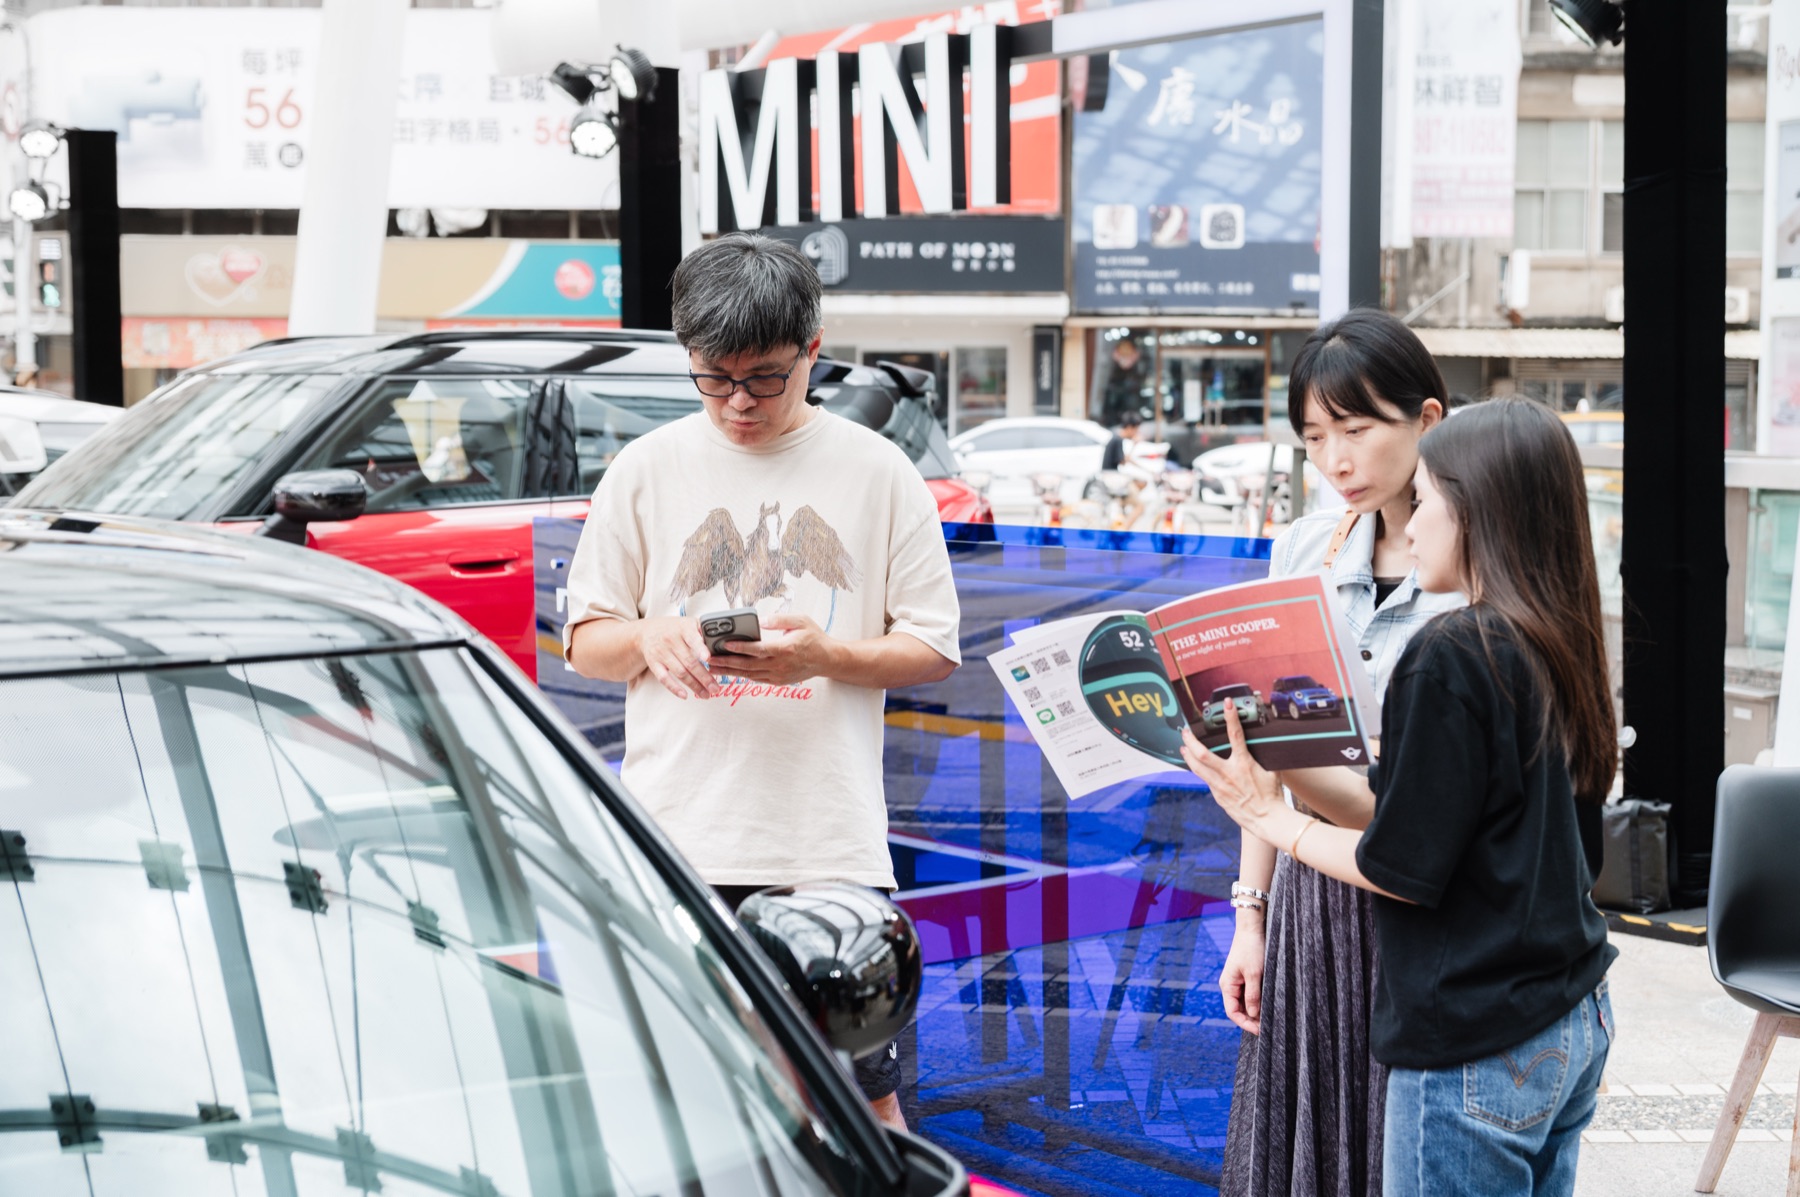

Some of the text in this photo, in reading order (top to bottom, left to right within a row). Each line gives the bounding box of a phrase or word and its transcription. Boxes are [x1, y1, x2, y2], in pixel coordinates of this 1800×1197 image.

[244, 86, 302, 129] 56
[699, 22, 1011, 235] MINI
[859, 241, 914, 259] PATH
[919, 241, 948, 259] OF
[1118, 630, 1145, 648] 52
[1170, 634, 1199, 652] THE
[1198, 626, 1230, 643] MINI
[1230, 617, 1281, 635] COOPER.
[1214, 641, 1223, 651] of
[1222, 638, 1238, 650] your
[694, 677, 813, 707] alifornia
[1104, 690, 1164, 718] Hey
